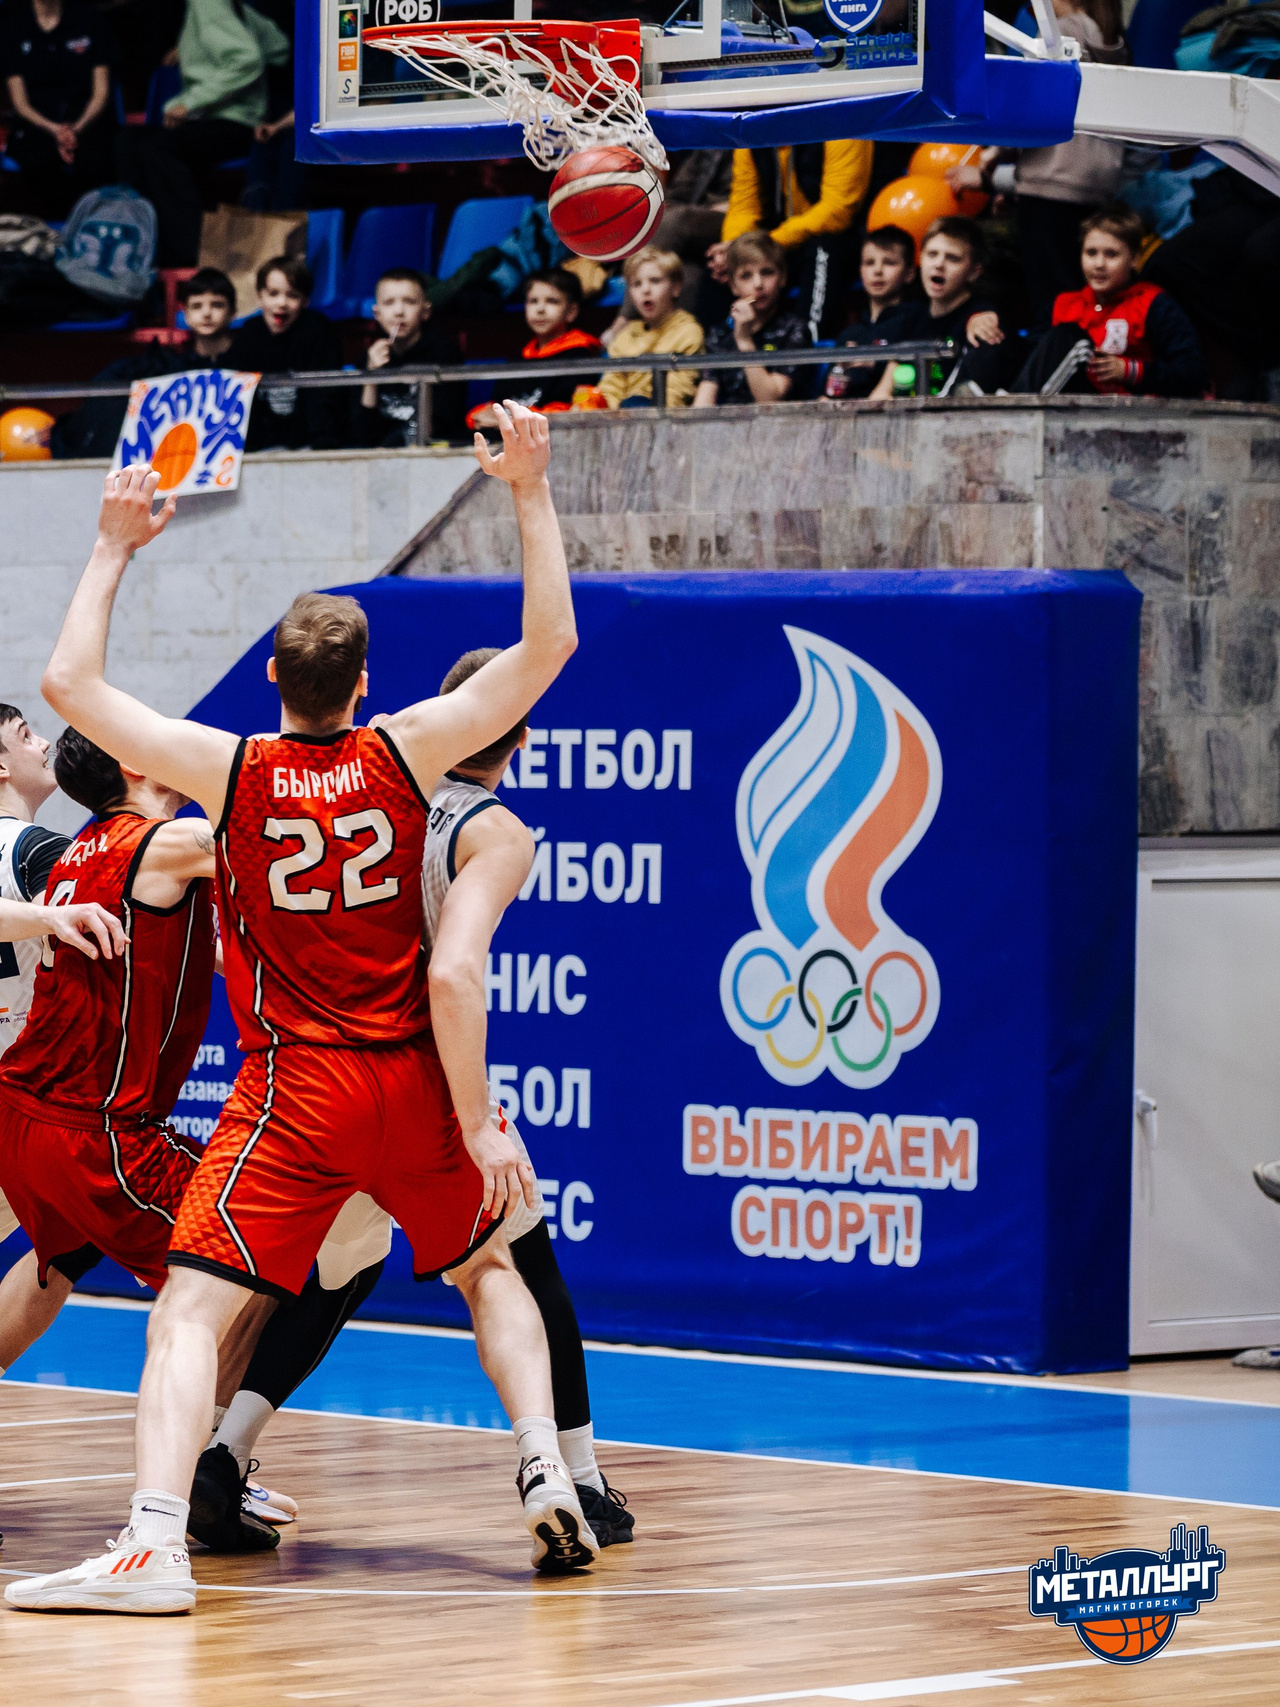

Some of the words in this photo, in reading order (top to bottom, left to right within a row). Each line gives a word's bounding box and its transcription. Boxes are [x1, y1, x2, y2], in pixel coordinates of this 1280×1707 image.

[383, 0, 433, 24] РФБ
[839, 4, 868, 14] ЛИГА
[272, 758, 367, 804] БЫРДИН
[261, 807, 401, 914] 22
[484, 952, 588, 1016] НИС
[488, 1063, 591, 1129] БОЛ
[687, 1110, 973, 1185] ВЫБИРАЕМ
[735, 1192, 918, 1261] СПОРТ!
[527, 1462, 561, 1476] TIME
